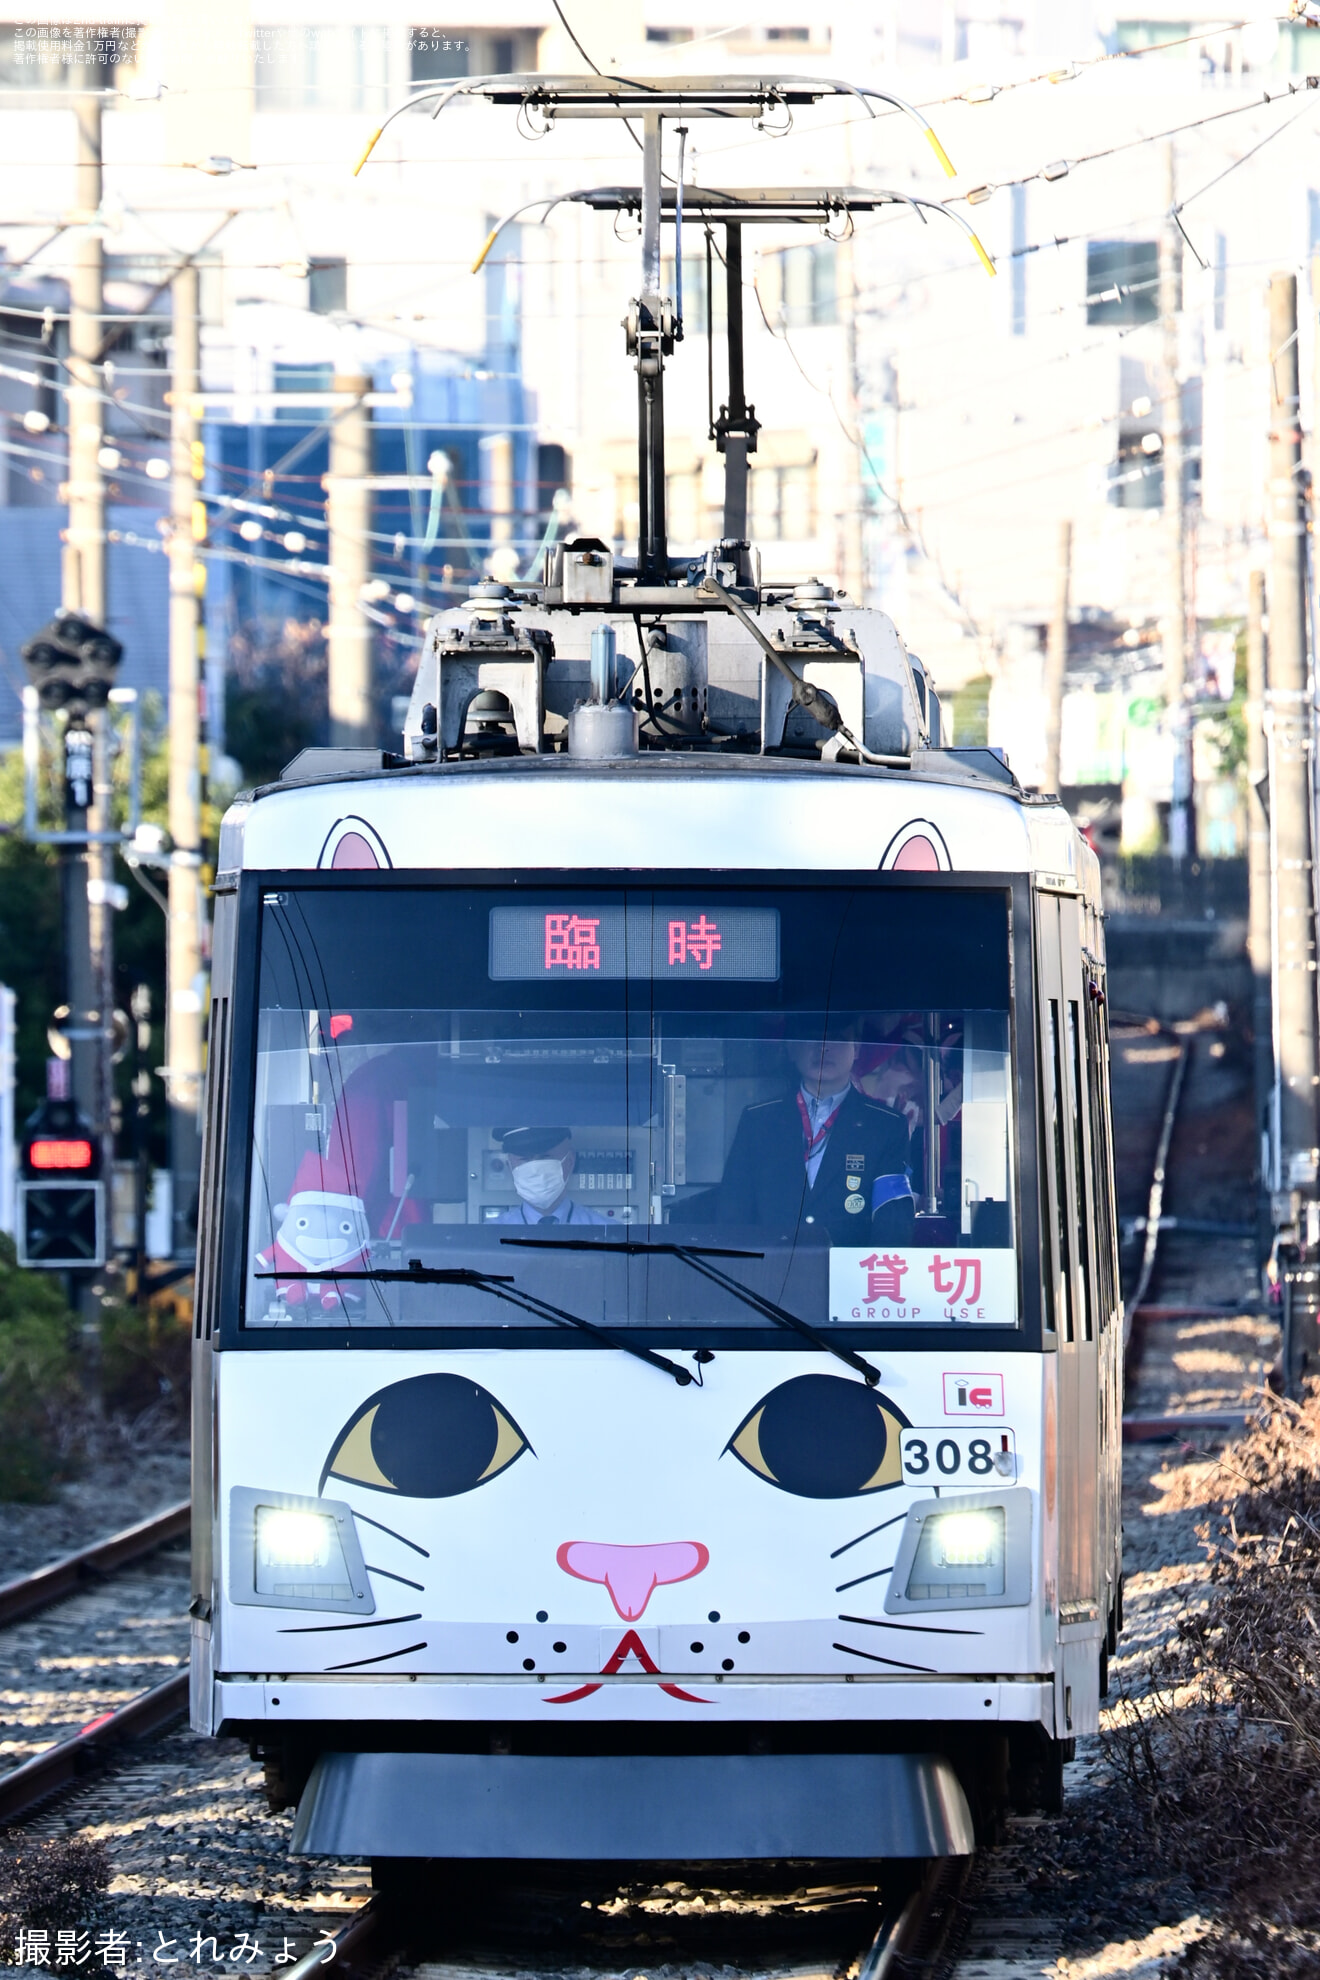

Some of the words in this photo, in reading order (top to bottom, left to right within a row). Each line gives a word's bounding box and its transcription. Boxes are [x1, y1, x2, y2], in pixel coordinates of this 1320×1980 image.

[545, 914, 721, 969] 臨時
[859, 1253, 981, 1306] 貸切
[851, 1307, 921, 1319] GROUP
[944, 1307, 985, 1319] USE
[904, 1439, 994, 1475] 308
